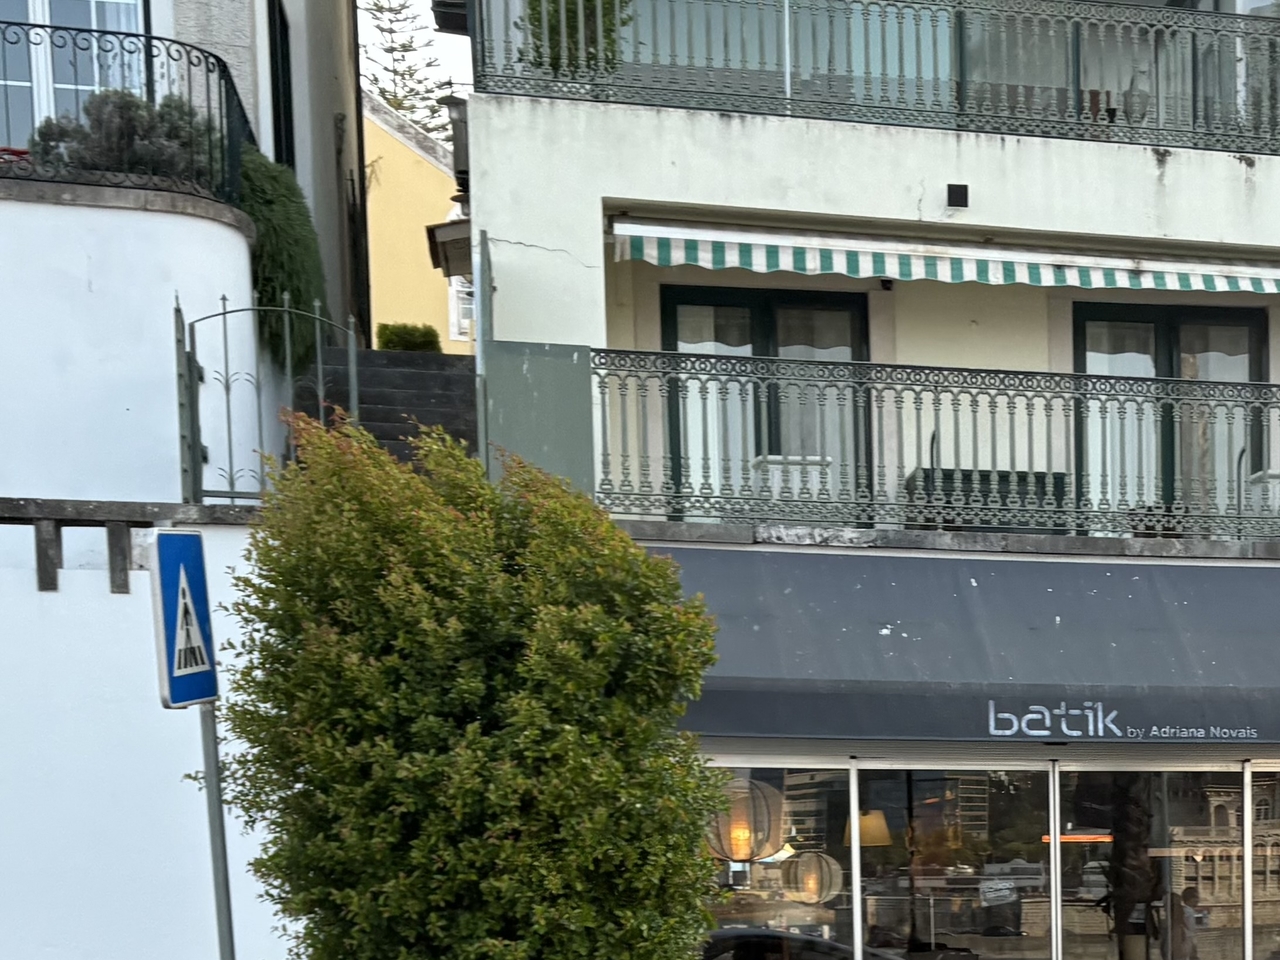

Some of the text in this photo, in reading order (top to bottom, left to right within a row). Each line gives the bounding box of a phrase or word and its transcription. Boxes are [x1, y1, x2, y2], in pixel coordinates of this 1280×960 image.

[988, 700, 1258, 740] batik by Adriana Novais
